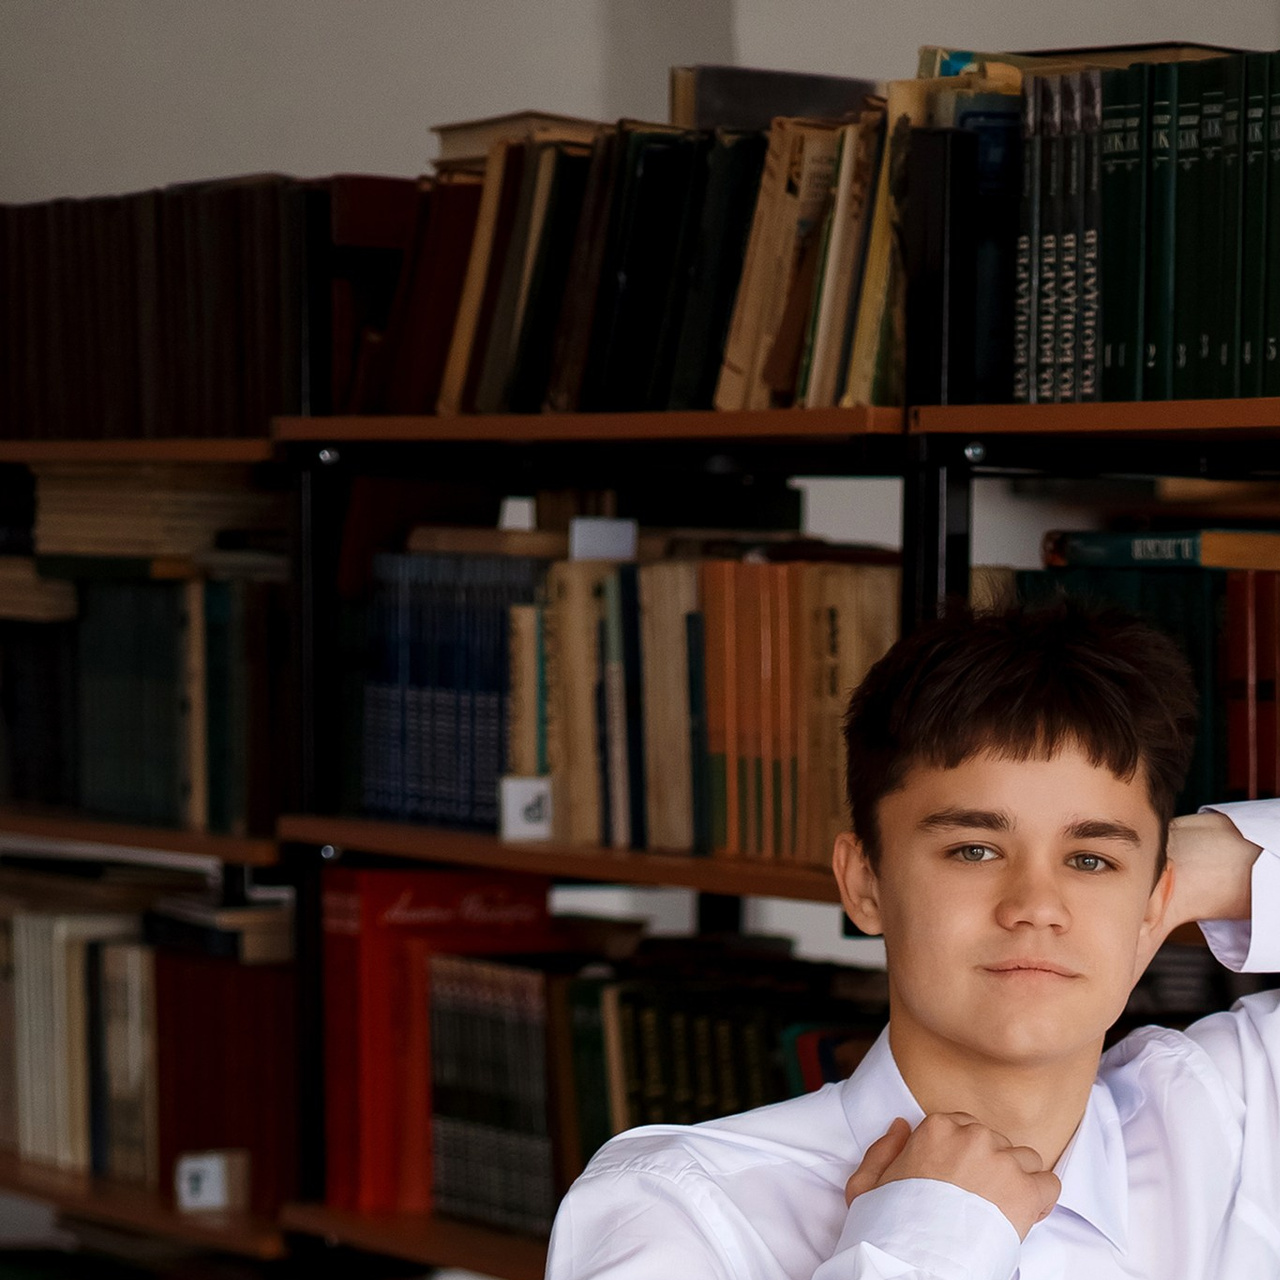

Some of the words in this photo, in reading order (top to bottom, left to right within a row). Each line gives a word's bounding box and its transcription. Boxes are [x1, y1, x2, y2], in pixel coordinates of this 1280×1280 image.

[1039, 233, 1057, 365] БОНДАРЕВ
[1059, 233, 1077, 365] БОНДАРЕВ
[1081, 229, 1099, 361] БОНДАРЕВ
[1147, 343, 1156, 368] 2
[1267, 337, 1276, 361] 5
